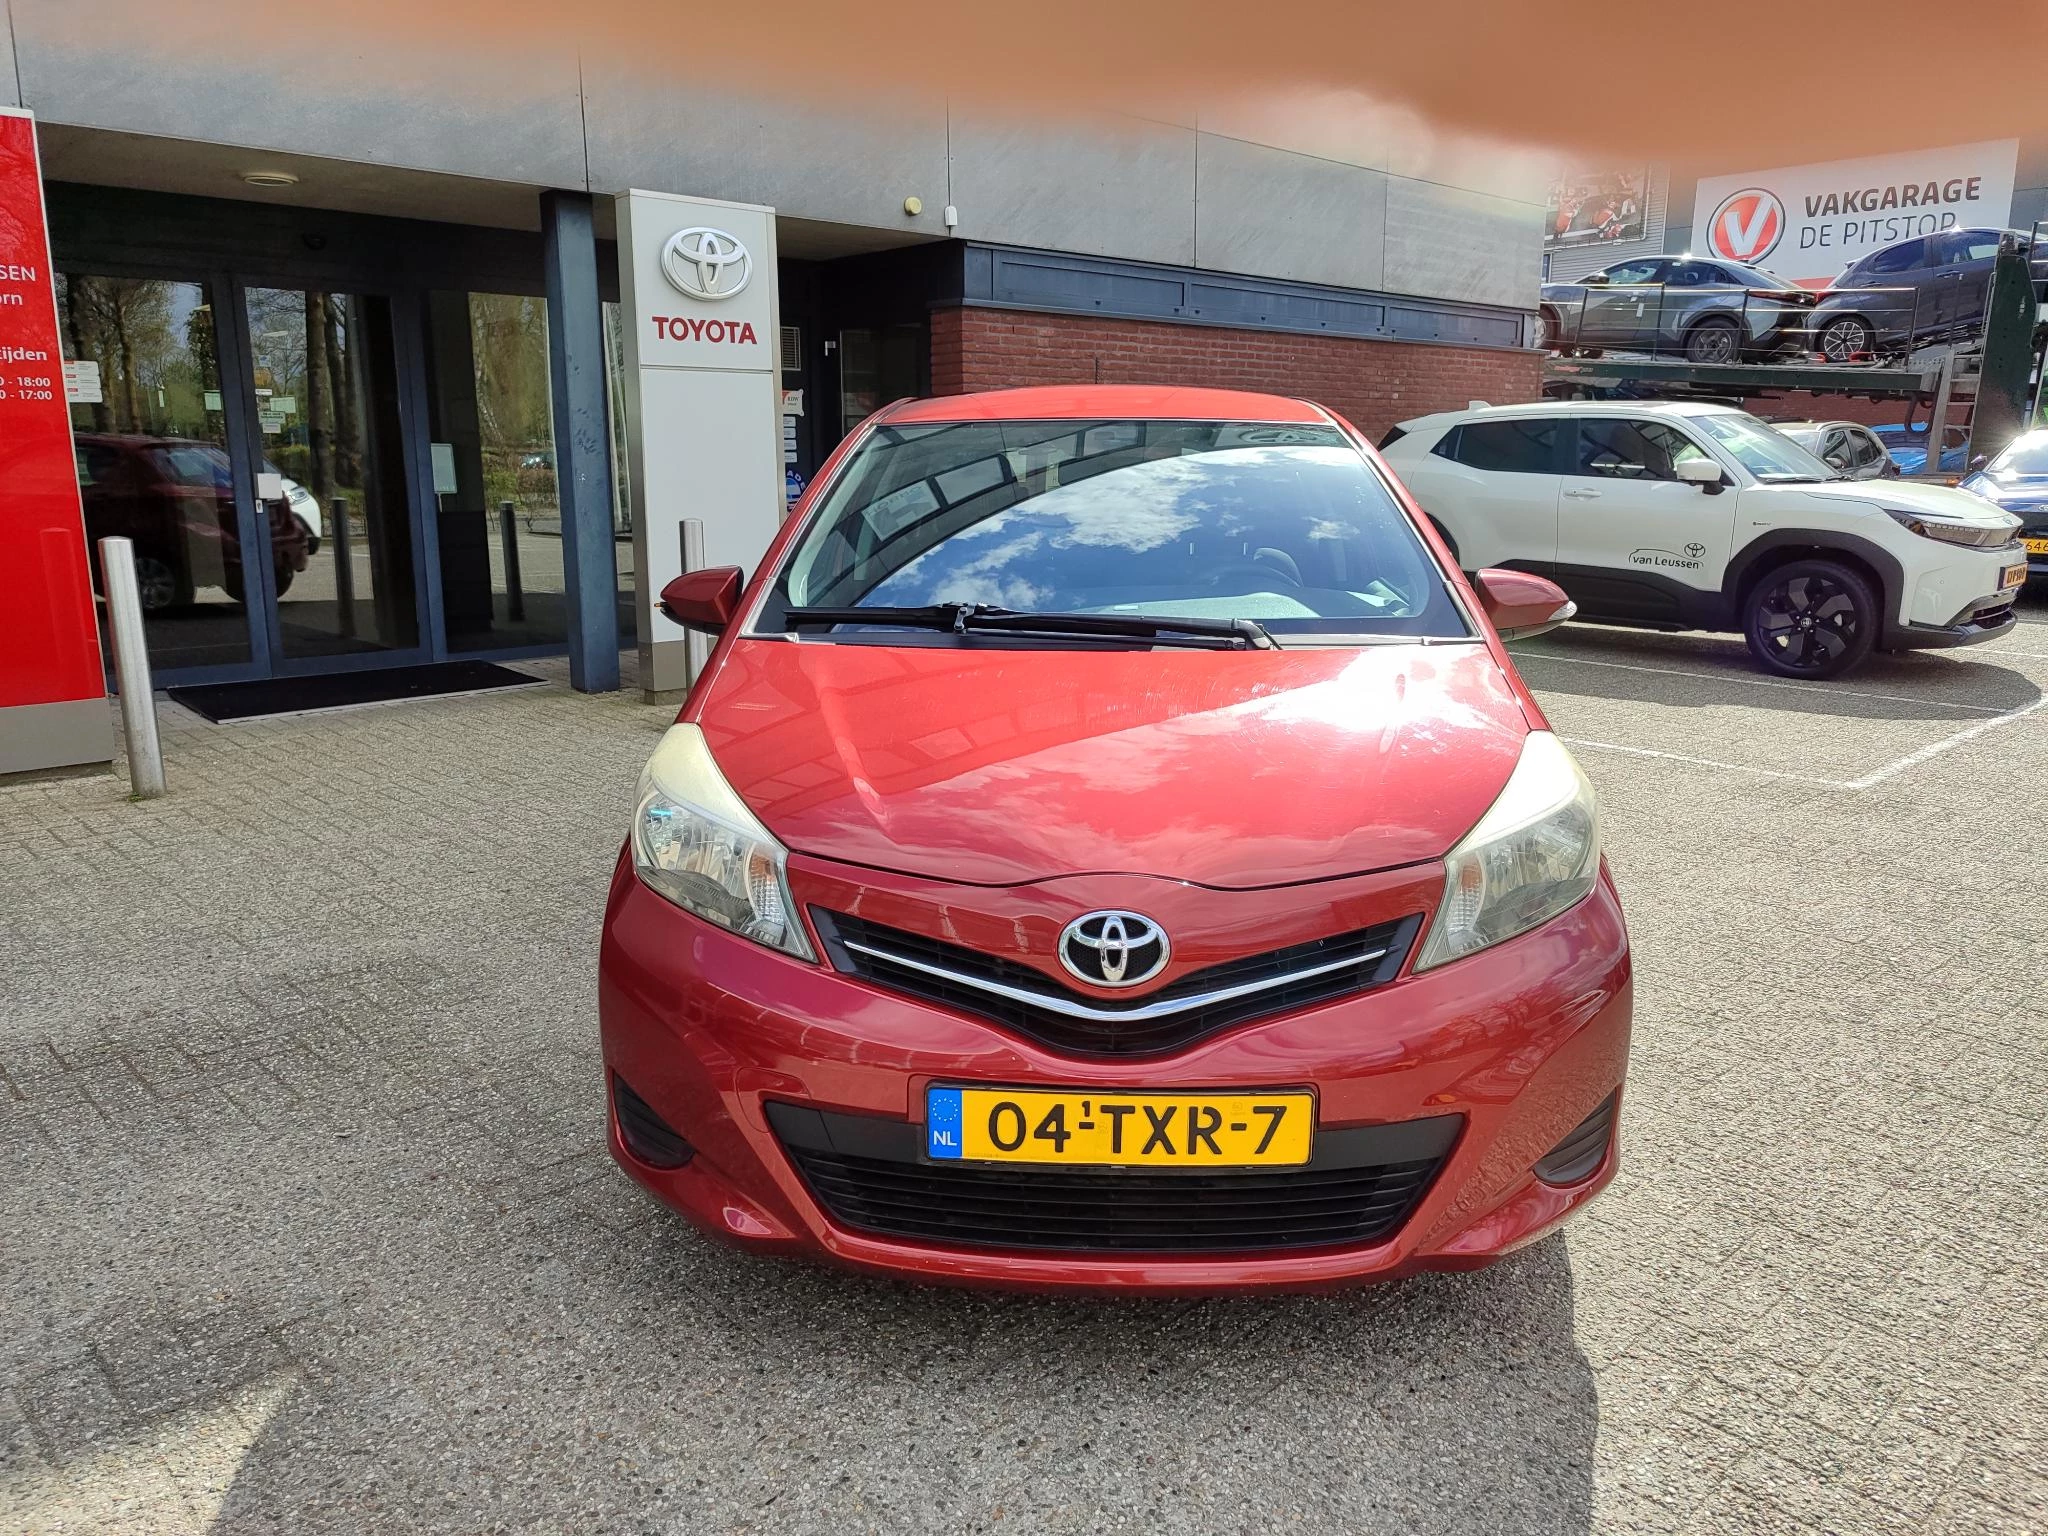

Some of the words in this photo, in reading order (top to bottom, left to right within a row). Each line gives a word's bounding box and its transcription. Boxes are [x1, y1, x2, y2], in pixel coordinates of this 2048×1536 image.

[1804, 176, 1982, 218] VAKGARAGE
[1799, 224, 1834, 249] DE
[1843, 211, 1957, 245] PITSTOP
[0, 293, 23, 306] rn
[651, 316, 758, 345] TOYOTA
[16, 376, 51, 387] 18:00
[18, 389, 53, 401] 17:00
[1632, 556, 1652, 566] van
[1654, 556, 1700, 570] Leussen
[933, 1130, 958, 1147] NL
